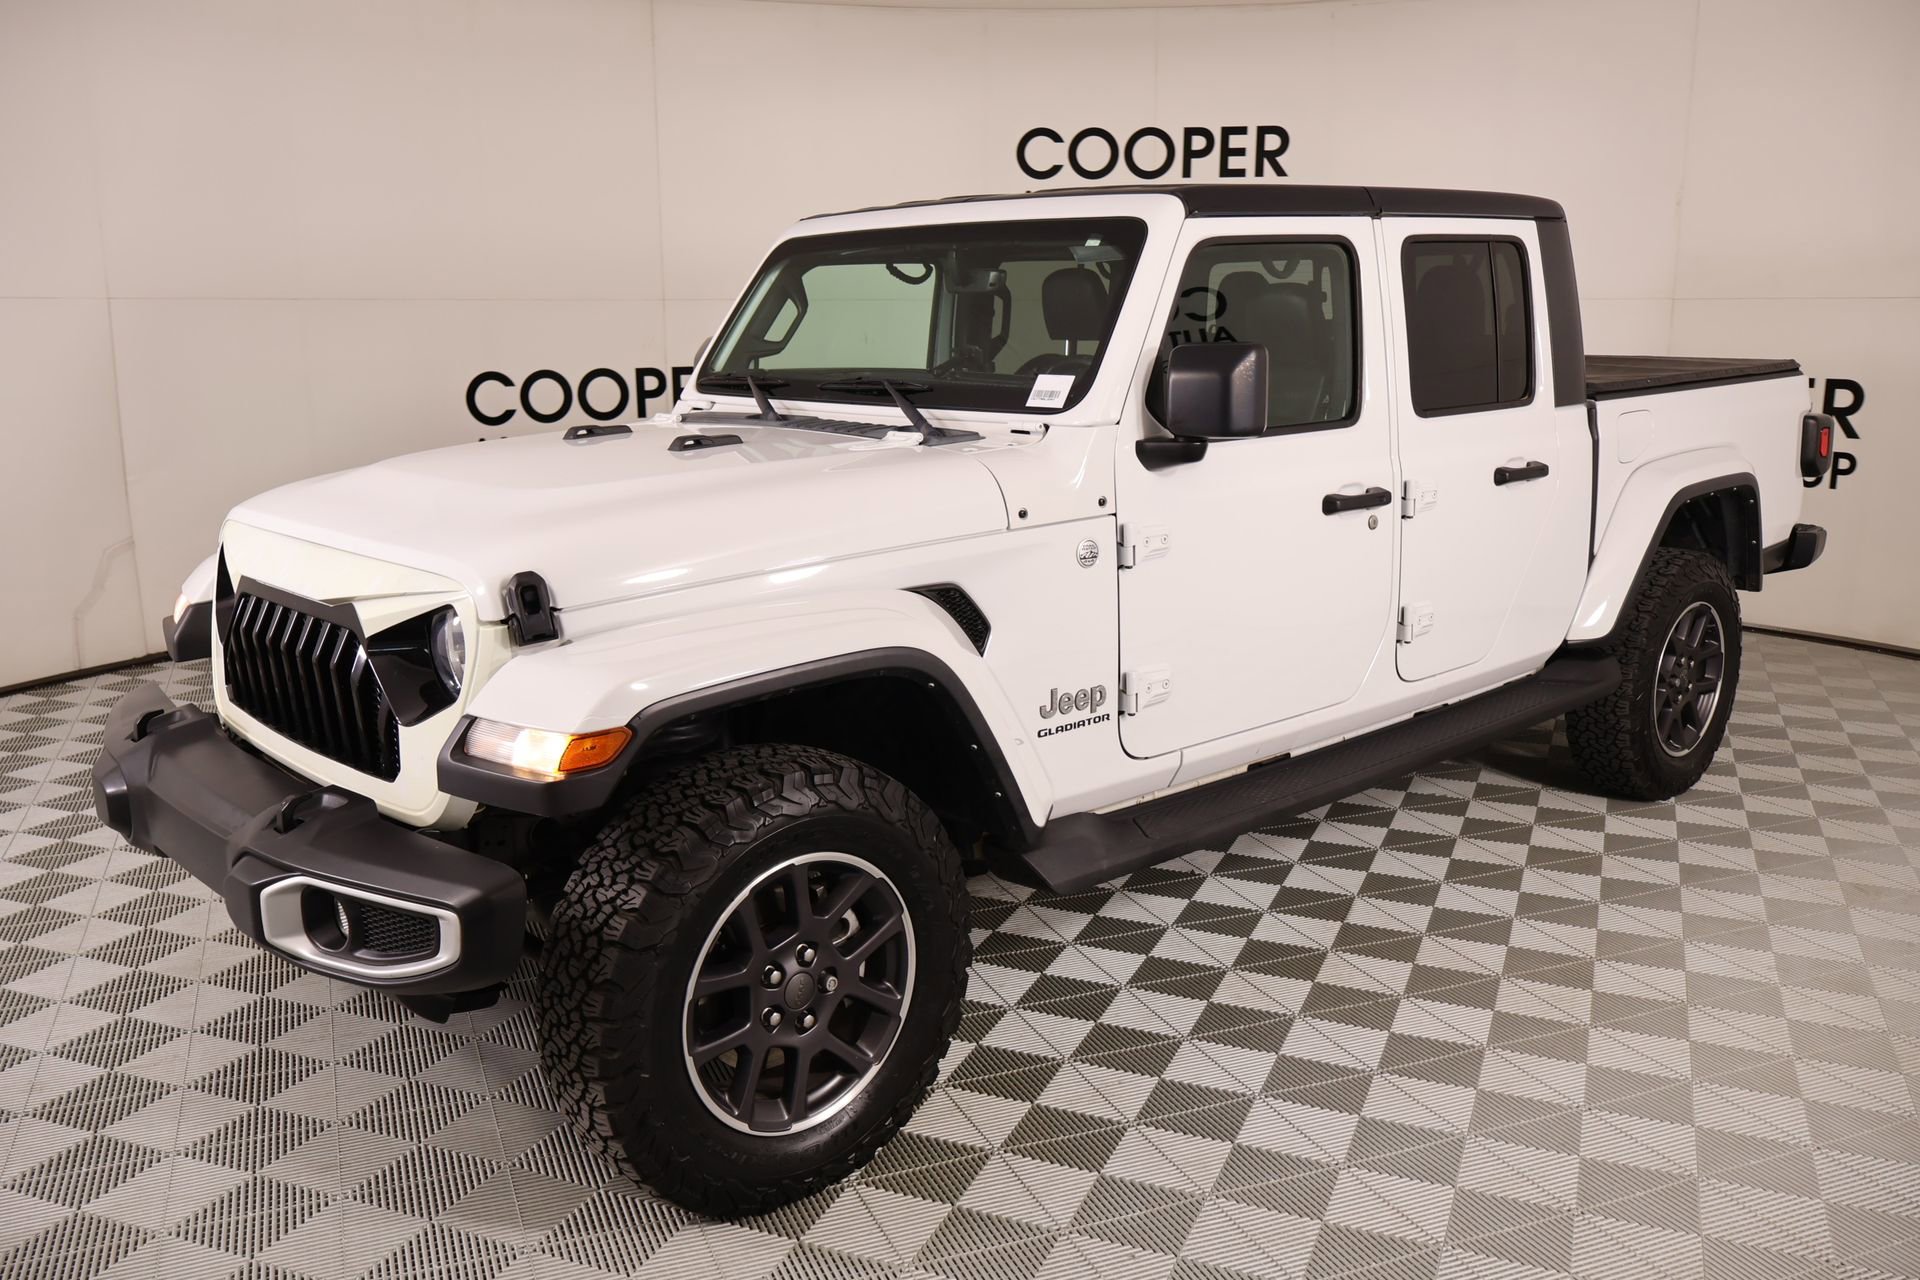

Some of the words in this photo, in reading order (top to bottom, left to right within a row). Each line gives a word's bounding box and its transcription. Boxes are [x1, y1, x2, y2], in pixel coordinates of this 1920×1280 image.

[1016, 125, 1290, 180] COOPER
[1039, 684, 1107, 719] Jeep
[1037, 713, 1110, 738] GLADIATOR
